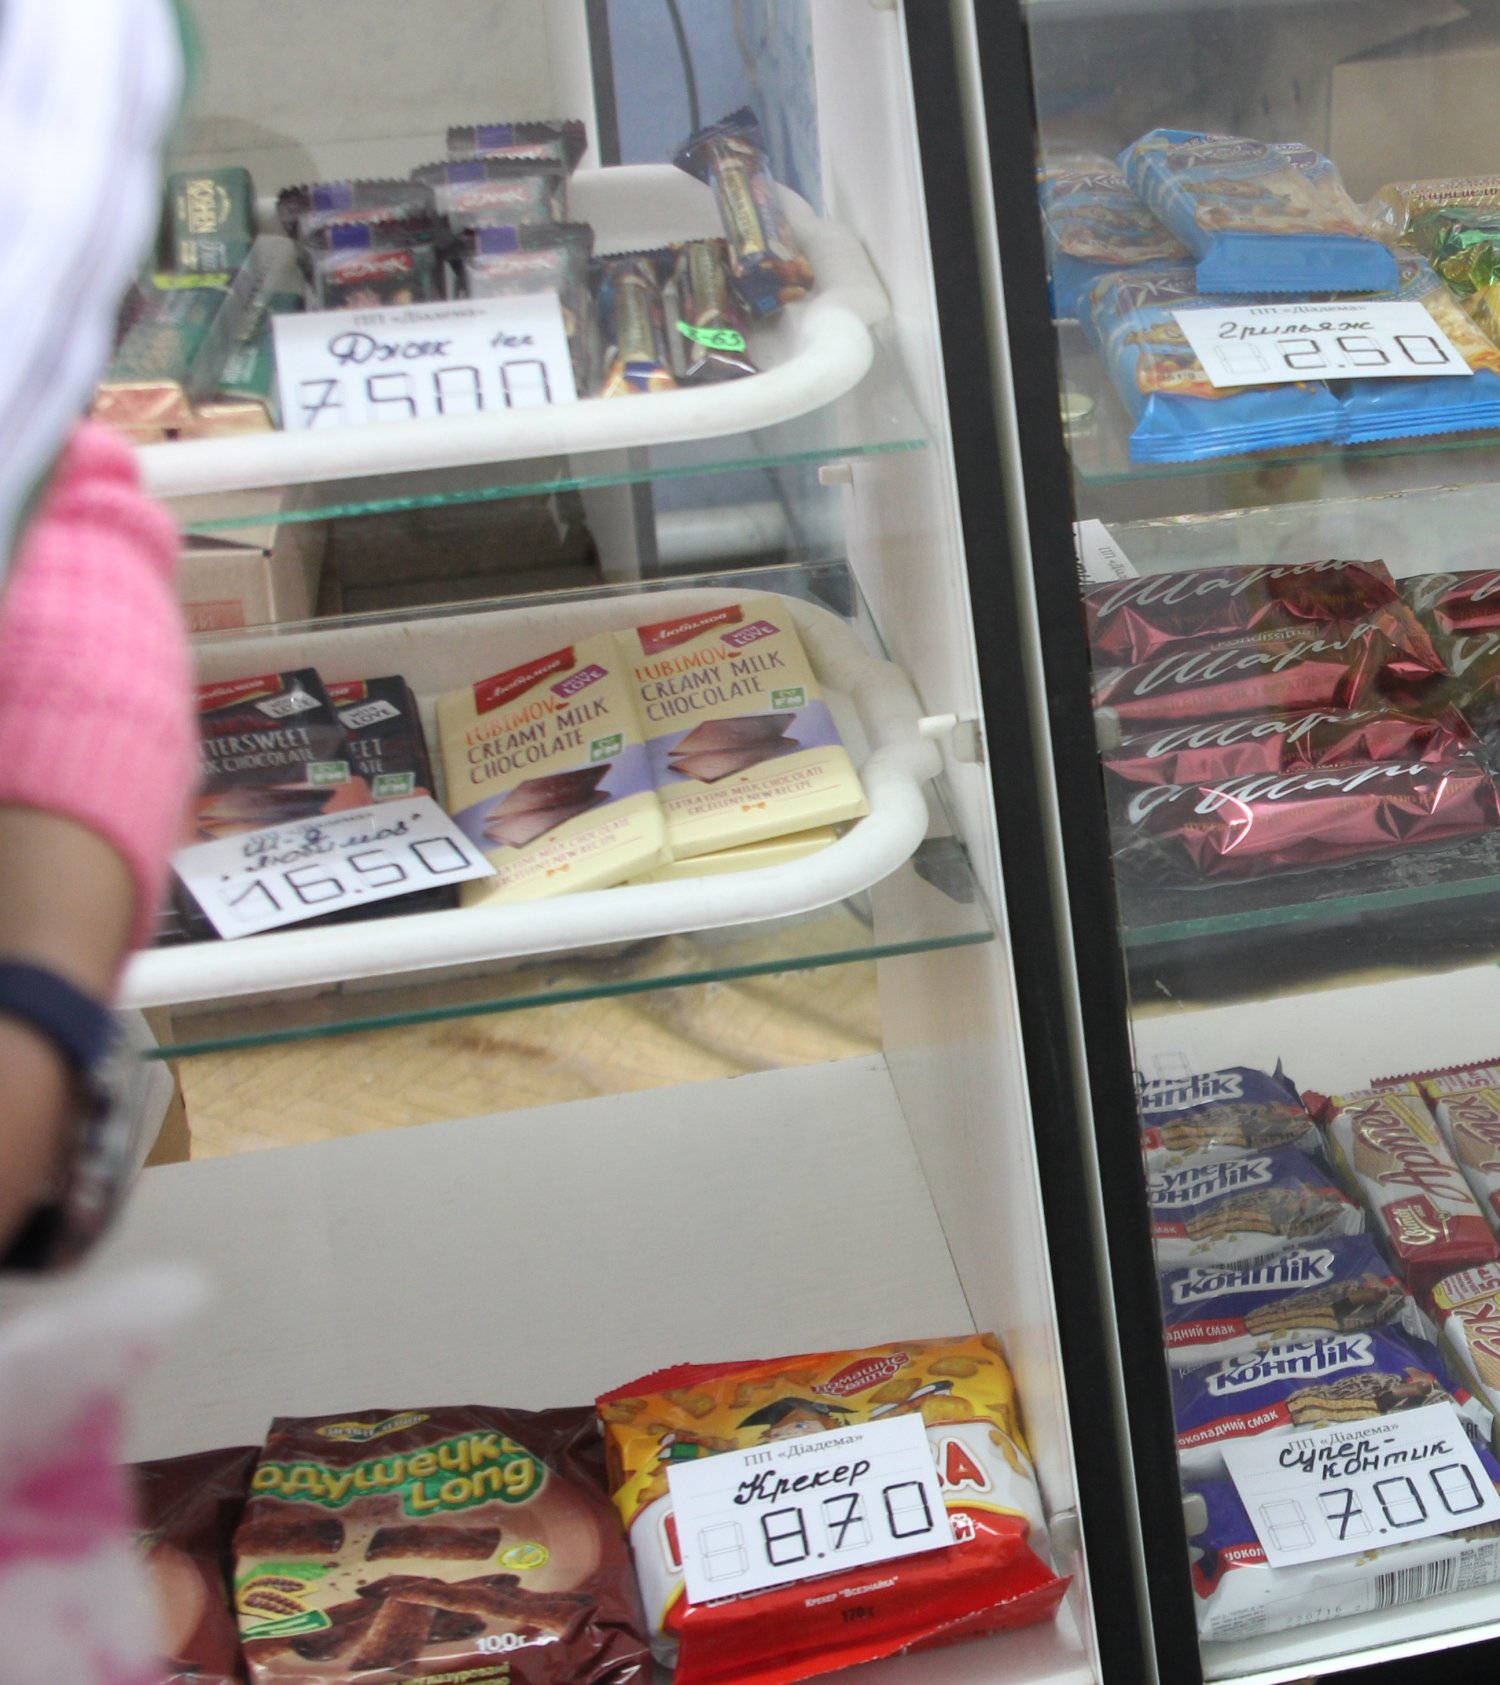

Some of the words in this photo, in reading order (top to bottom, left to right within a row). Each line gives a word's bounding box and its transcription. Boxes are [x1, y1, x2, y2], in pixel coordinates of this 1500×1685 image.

[1218, 319, 1375, 341] Грильяж
[1277, 334, 1452, 371] 2.50
[732, 626, 775, 647] LOVE
[563, 670, 602, 695] LOVE
[635, 644, 728, 685] LUBIMOV
[640, 669, 723, 703] CREAMY
[730, 651, 786, 681] MILK
[352, 711, 394, 728] LOVE
[645, 677, 766, 722] CHOCOLATE
[465, 696, 558, 747] LUBIMOV
[466, 721, 548, 765] CREAMY
[556, 697, 610, 731] MILK
[469, 729, 585, 784] CHOCOLATE
[229, 836, 472, 911] 16.50
[1206, 1323, 1236, 1337] смак
[1178, 1416, 1246, 1446] околадний
[1247, 1409, 1279, 1427] смак
[1320, 1423, 1400, 1448] «Діадема»
[743, 1450, 774, 1467] ПП
[778, 1432, 864, 1461] «Діадема»
[1322, 1441, 1454, 1481] контик
[410, 1456, 536, 1510] Long
[734, 1459, 871, 1505] Крекер
[1319, 1463, 1485, 1541] 7.00
[760, 1480, 934, 1567] 8.70
